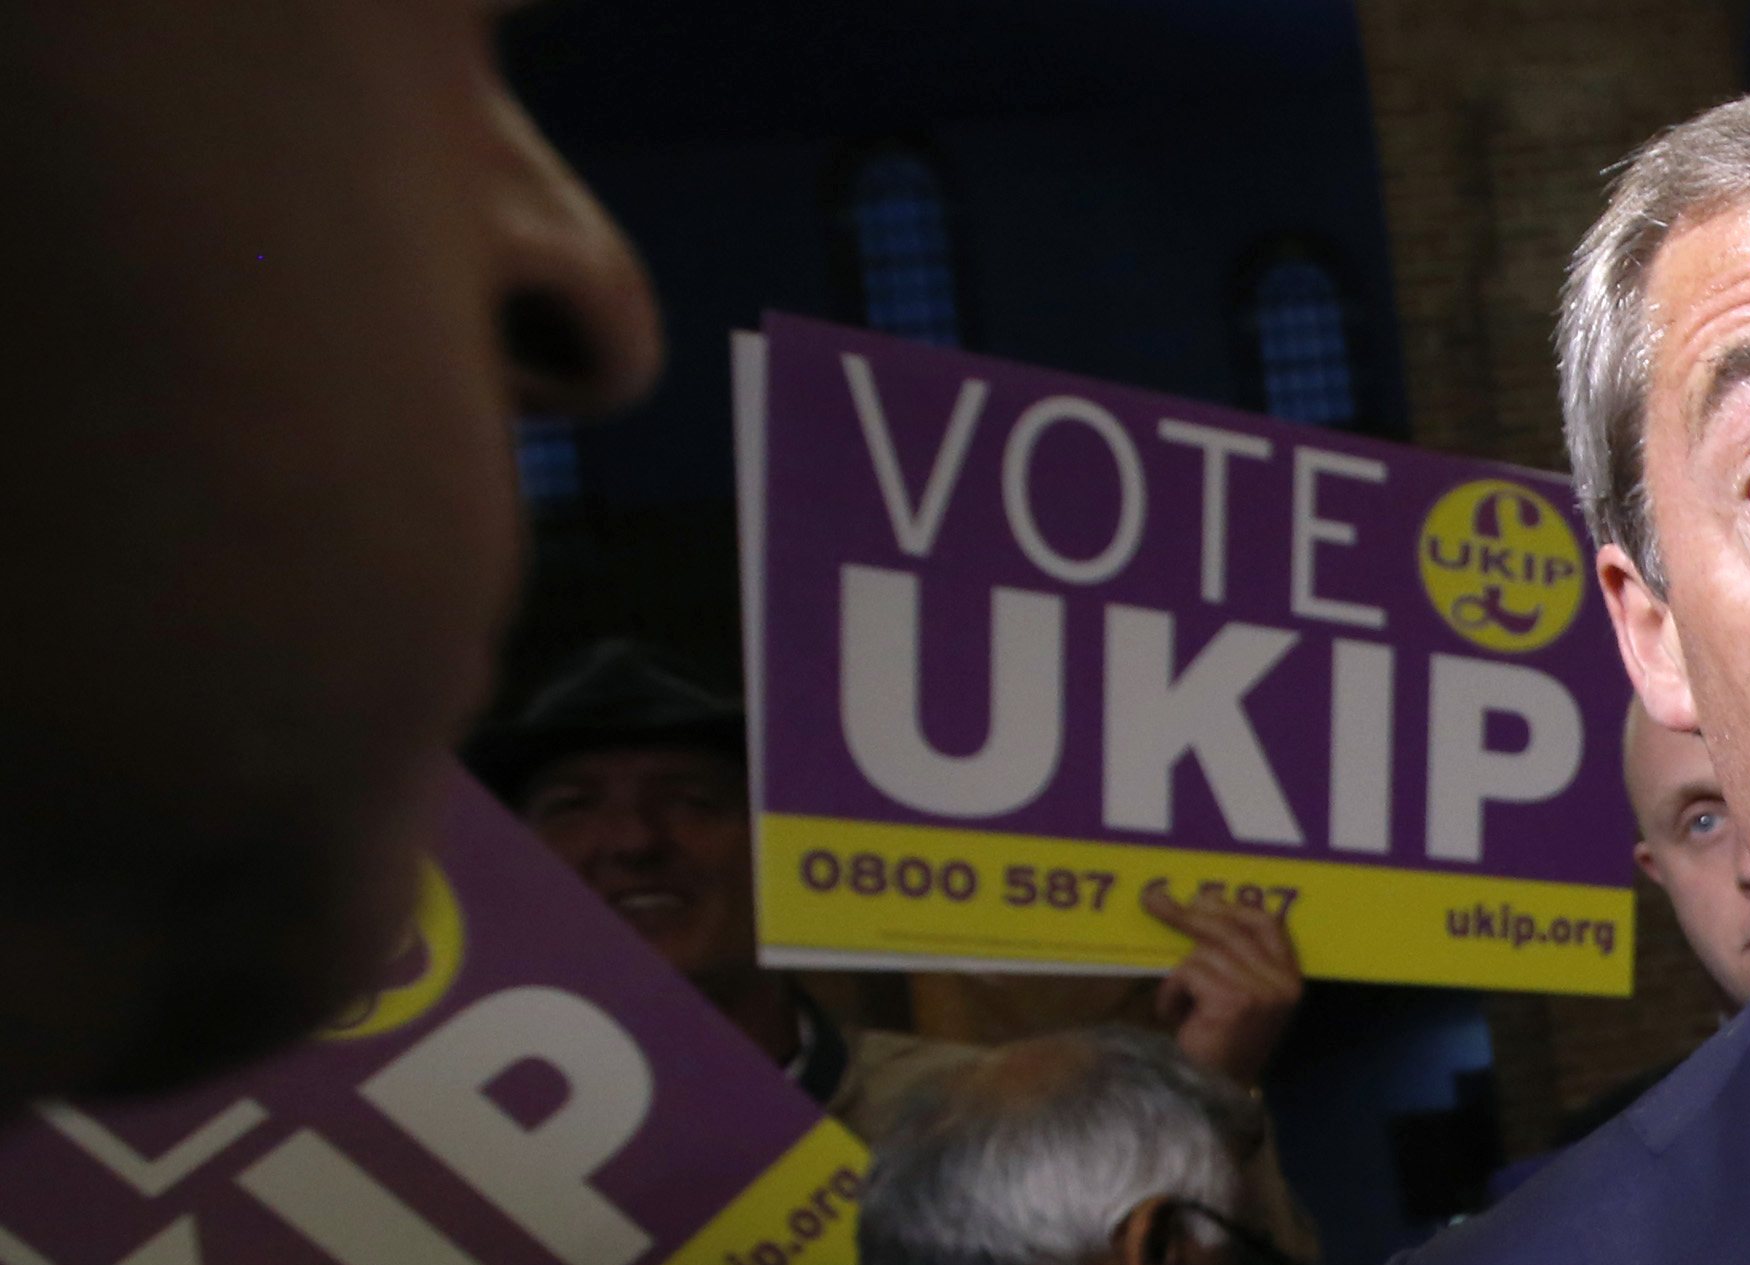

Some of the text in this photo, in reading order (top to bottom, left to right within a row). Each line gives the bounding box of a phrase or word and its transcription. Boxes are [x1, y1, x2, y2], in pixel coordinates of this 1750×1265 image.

[840, 352, 1388, 629] VOTE
[1427, 534, 1579, 588] UKIP
[839, 562, 1584, 864] UKIP
[799, 848, 979, 903] 0800
[1003, 864, 1117, 912] 587
[1199, 879, 1299, 921] 87
[1446, 904, 1617, 955] ukip.org
